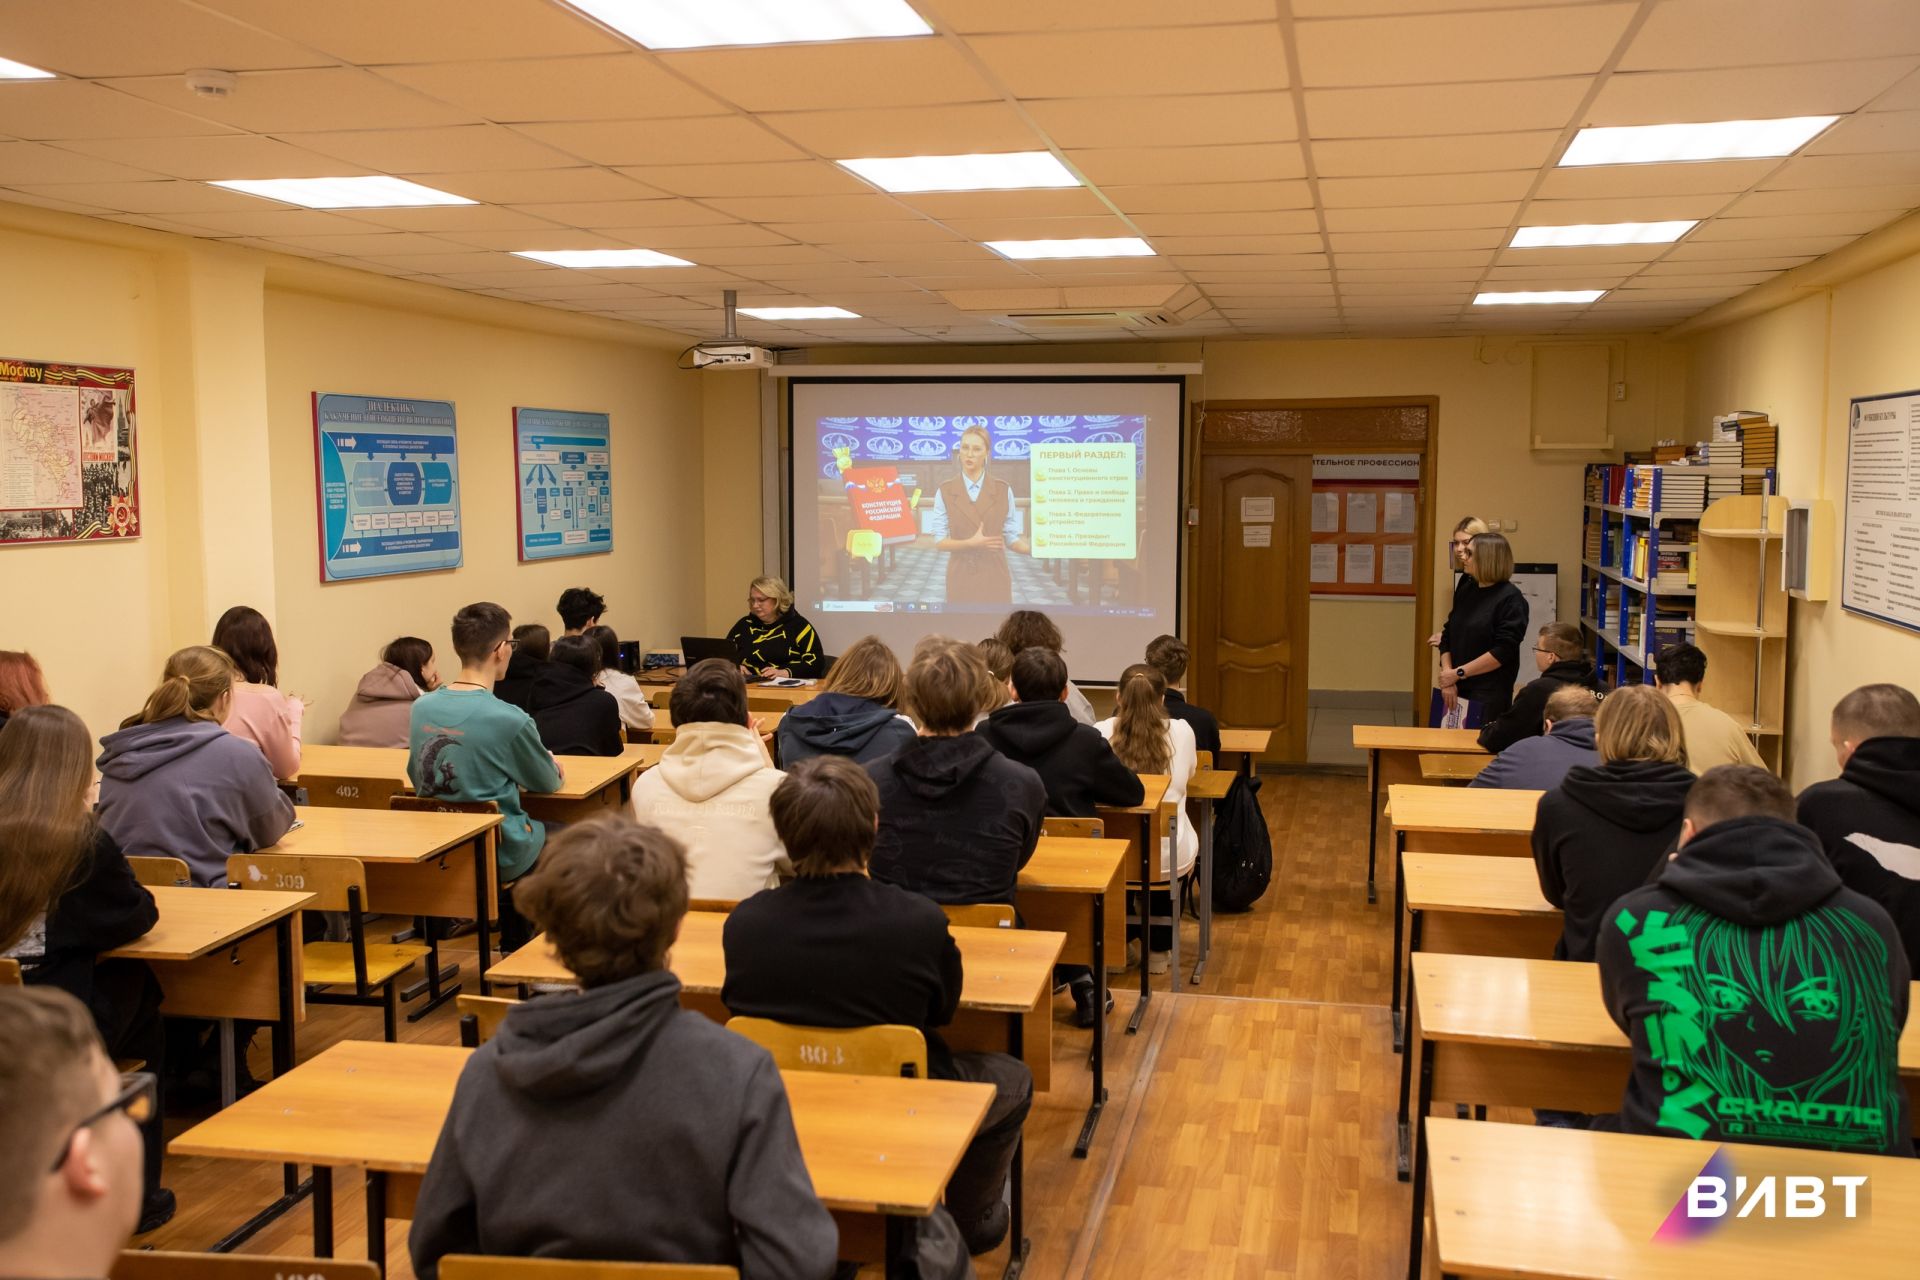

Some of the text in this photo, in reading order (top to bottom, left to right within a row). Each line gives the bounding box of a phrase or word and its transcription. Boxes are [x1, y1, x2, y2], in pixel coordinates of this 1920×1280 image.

[0, 362, 42, 381] Москву
[366, 400, 415, 413] ДИАЛЕКТИКА
[1040, 449, 1126, 460] ПЕРВЫЙ РАЗДЕЛ:
[861, 499, 902, 508] КОНСТИТУЦИЯ
[865, 506, 902, 515] РОССИЙСКОЙ
[868, 513, 901, 521] ФЕДЕРАЦИИ
[336, 785, 359, 798] 402
[275, 874, 305, 889] 309
[1717, 1096, 1883, 1125] CHAOTIC
